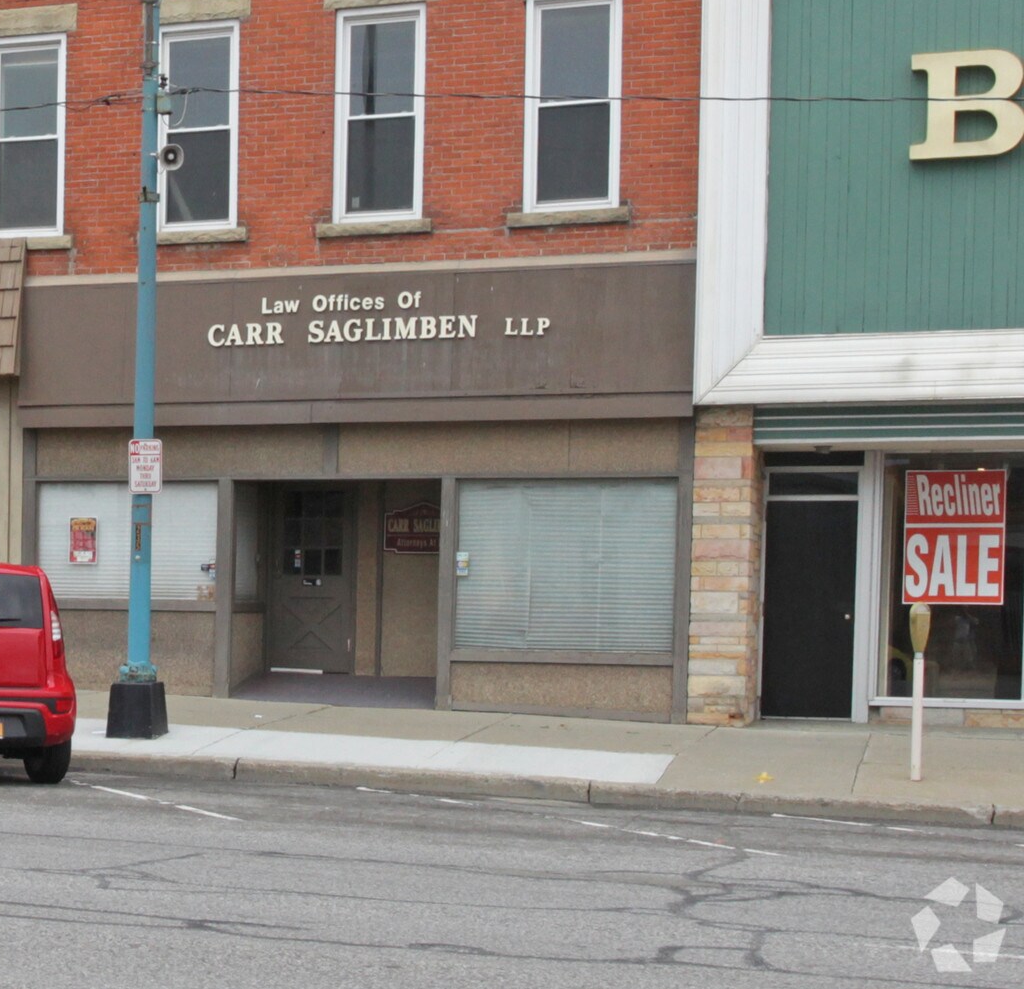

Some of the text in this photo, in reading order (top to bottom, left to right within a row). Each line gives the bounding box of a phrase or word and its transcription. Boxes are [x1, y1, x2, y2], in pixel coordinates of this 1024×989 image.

[909, 49, 1024, 161] B
[261, 291, 422, 314] Law Offices Of
[207, 315, 551, 347] CARR SAGLIMBEN LLP
[916, 474, 1000, 516] Recliner
[387, 518, 409, 532] CARR
[905, 533, 1000, 598] SALE
